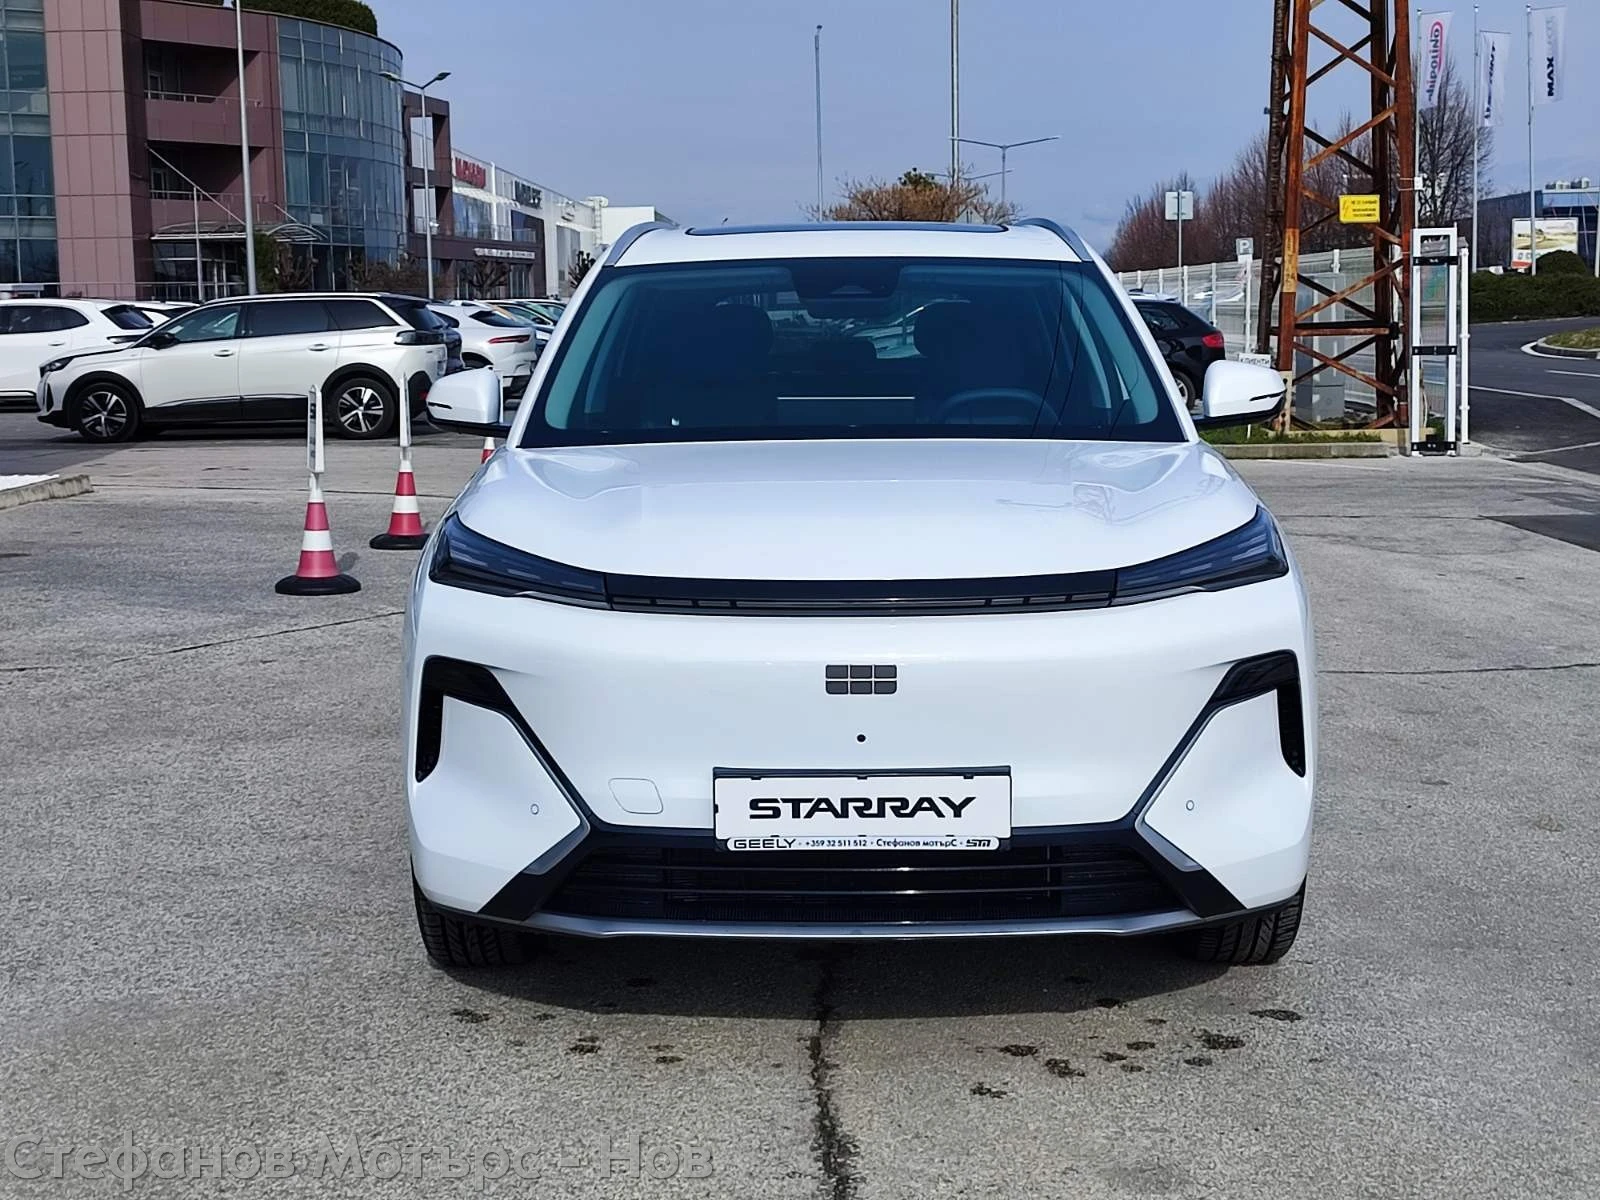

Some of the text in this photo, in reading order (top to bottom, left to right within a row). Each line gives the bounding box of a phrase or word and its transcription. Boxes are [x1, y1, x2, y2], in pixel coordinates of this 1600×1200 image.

[1240, 238, 1250, 253] P
[749, 796, 977, 819] STARRAY
[733, 838, 796, 849] GEELY
[806, 839, 825, 847] +359
[826, 839, 836, 847] 32
[837, 839, 851, 847] 511
[853, 839, 867, 847] 512
[876, 838, 921, 848] Стефанов
